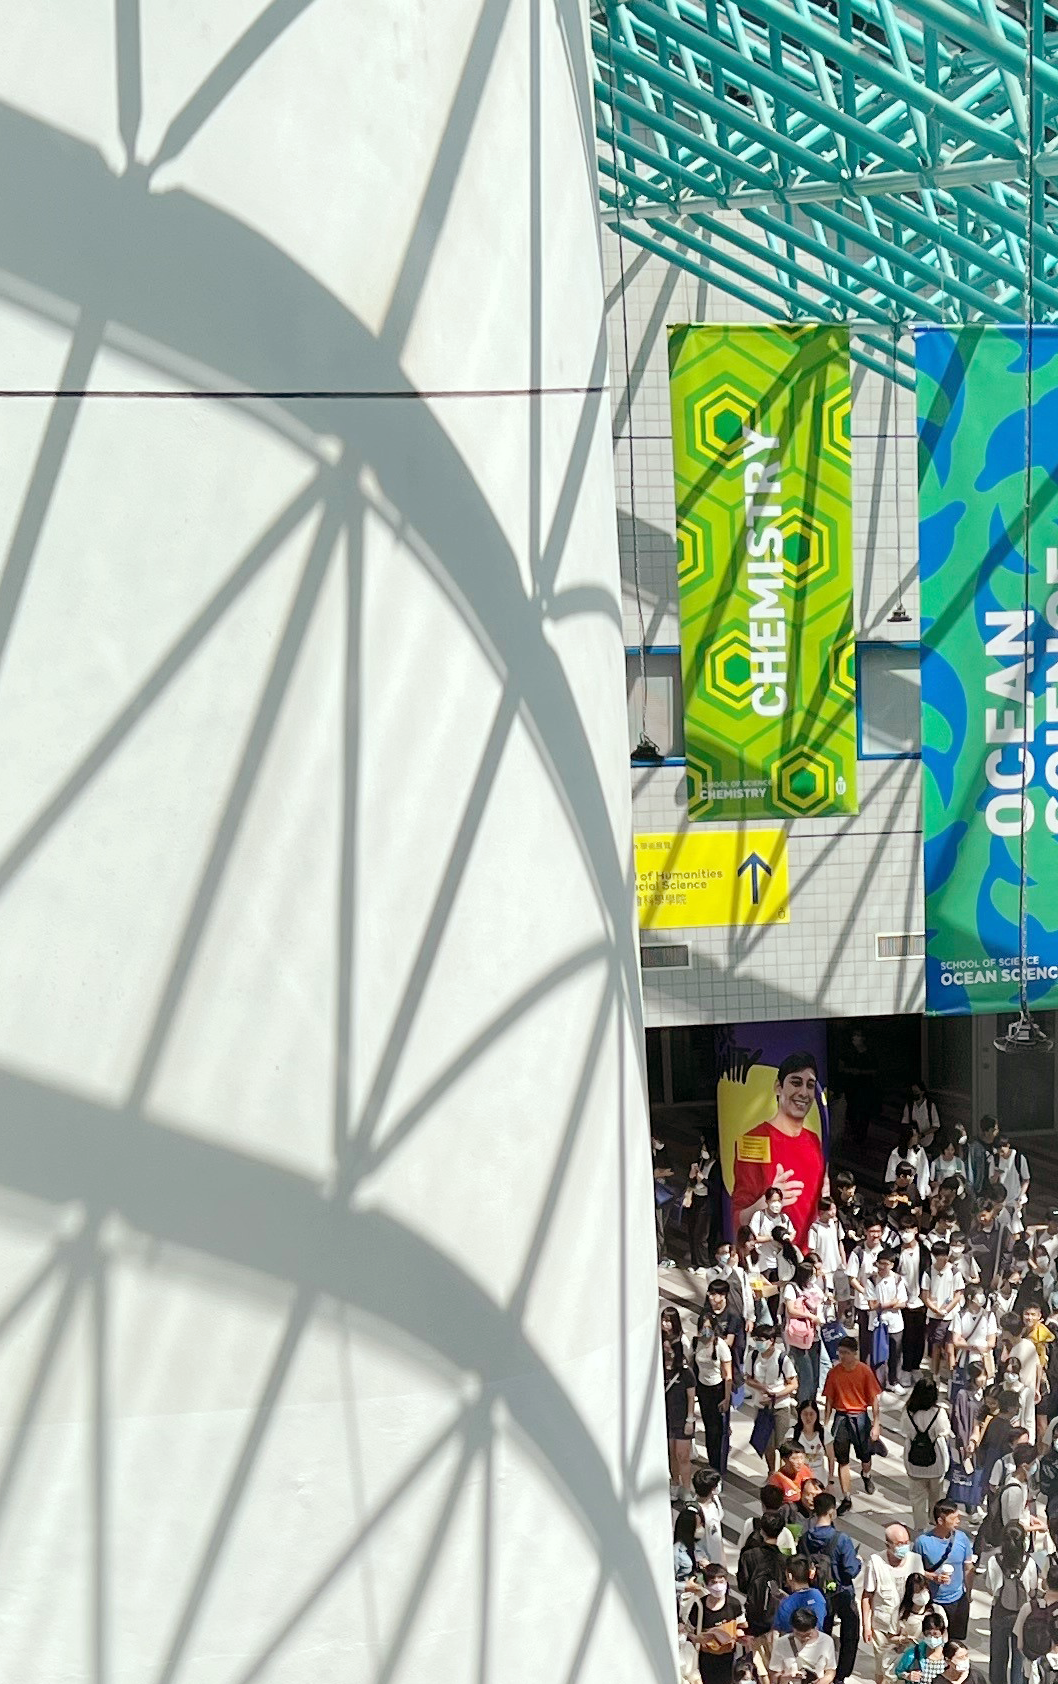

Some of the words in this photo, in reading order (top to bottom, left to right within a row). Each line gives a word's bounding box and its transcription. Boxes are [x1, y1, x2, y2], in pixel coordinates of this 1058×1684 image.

[744, 427, 788, 718] CHEMISTRY
[983, 609, 1036, 838] OCEAN
[700, 787, 766, 800] CHEMISTRY
[640, 871, 654, 880] of
[656, 869, 723, 880] Humanities
[662, 880, 707, 890] Science
[940, 959, 980, 970] SCHOOL
[982, 958, 996, 968] OF
[999, 956, 1040, 966] SCIECE
[940, 969, 998, 987] OCEAN
